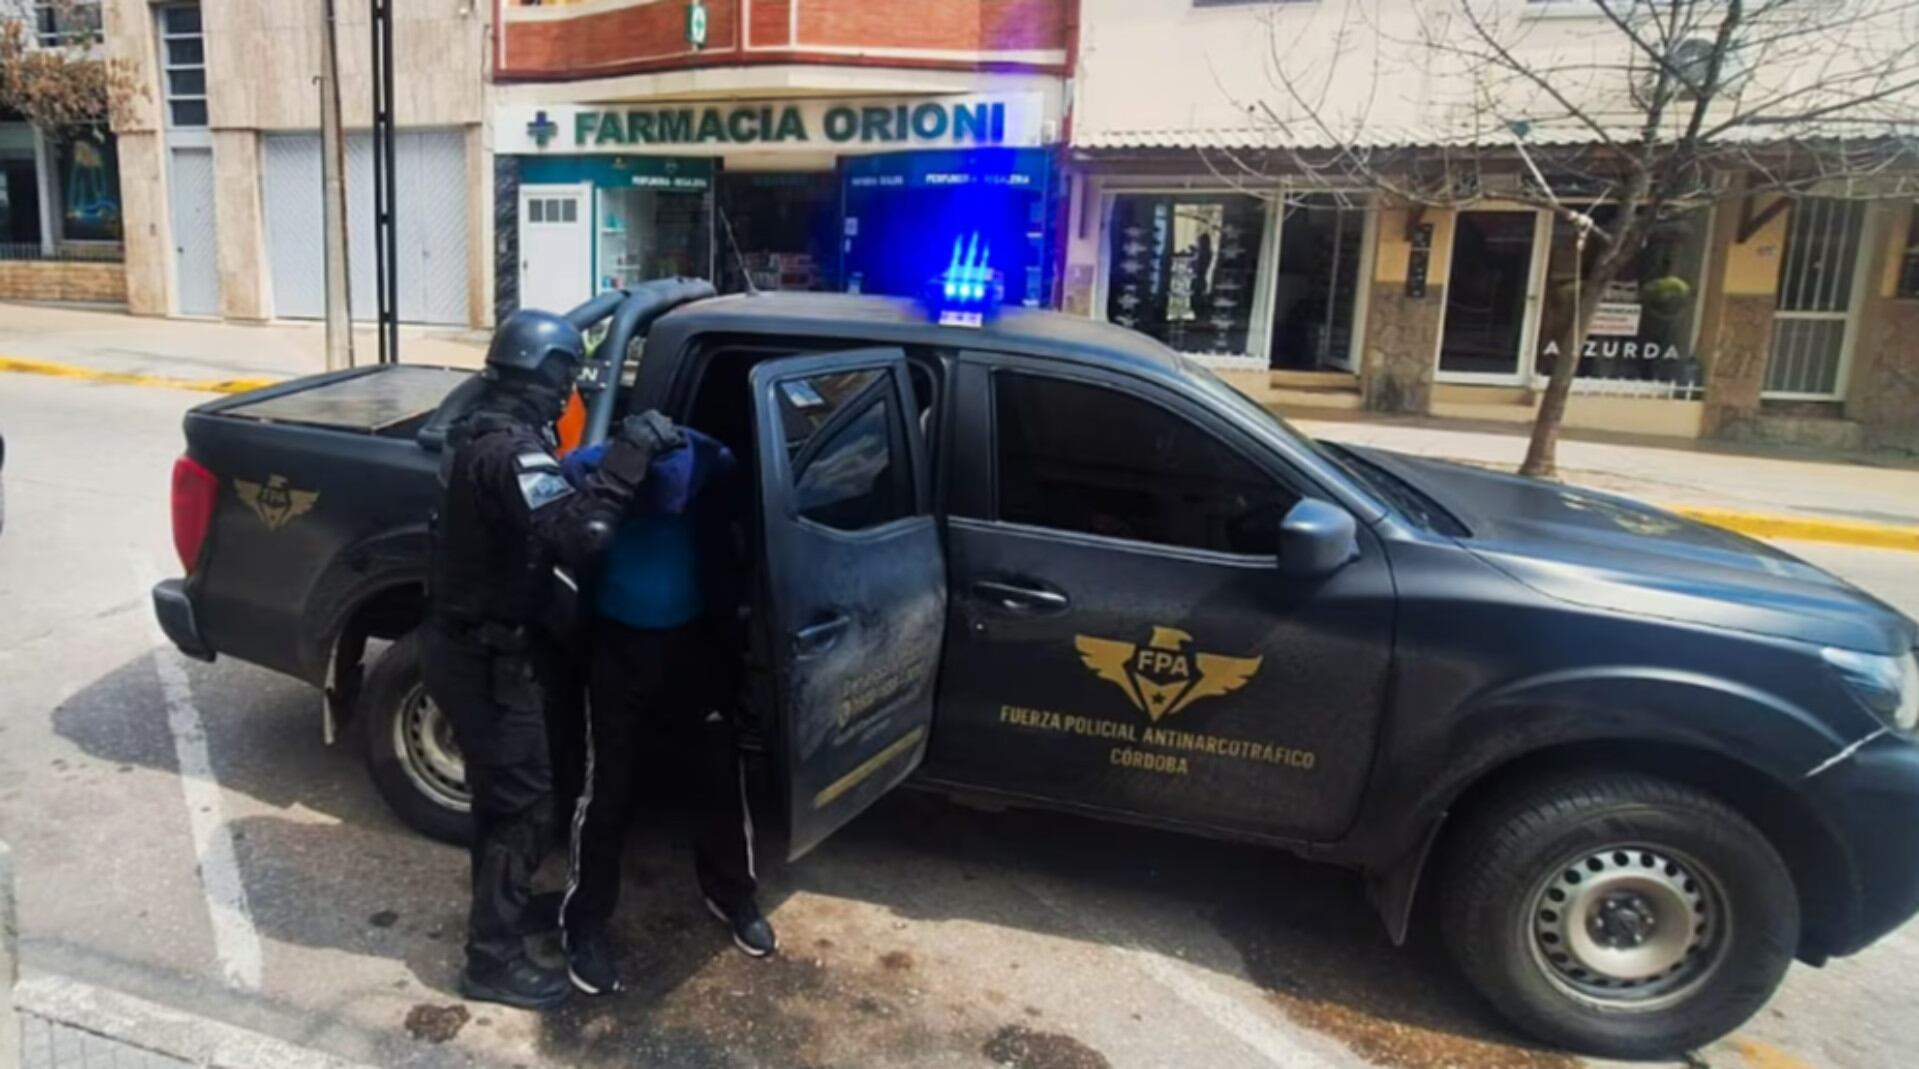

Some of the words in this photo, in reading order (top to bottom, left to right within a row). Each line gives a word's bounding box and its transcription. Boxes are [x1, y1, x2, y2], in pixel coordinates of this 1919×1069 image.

[574, 106, 808, 145] FARMACIA
[823, 102, 1005, 143] ORIONI
[1543, 340, 1680, 359] AZURDA
[1137, 650, 1190, 677] FPA
[1000, 705, 1062, 732] FUERZA
[1064, 715, 1136, 743] POLICIAL
[1142, 727, 1316, 770] ANTINARCOTRÁFICO
[1110, 746, 1189, 775] CÓRDOBA
